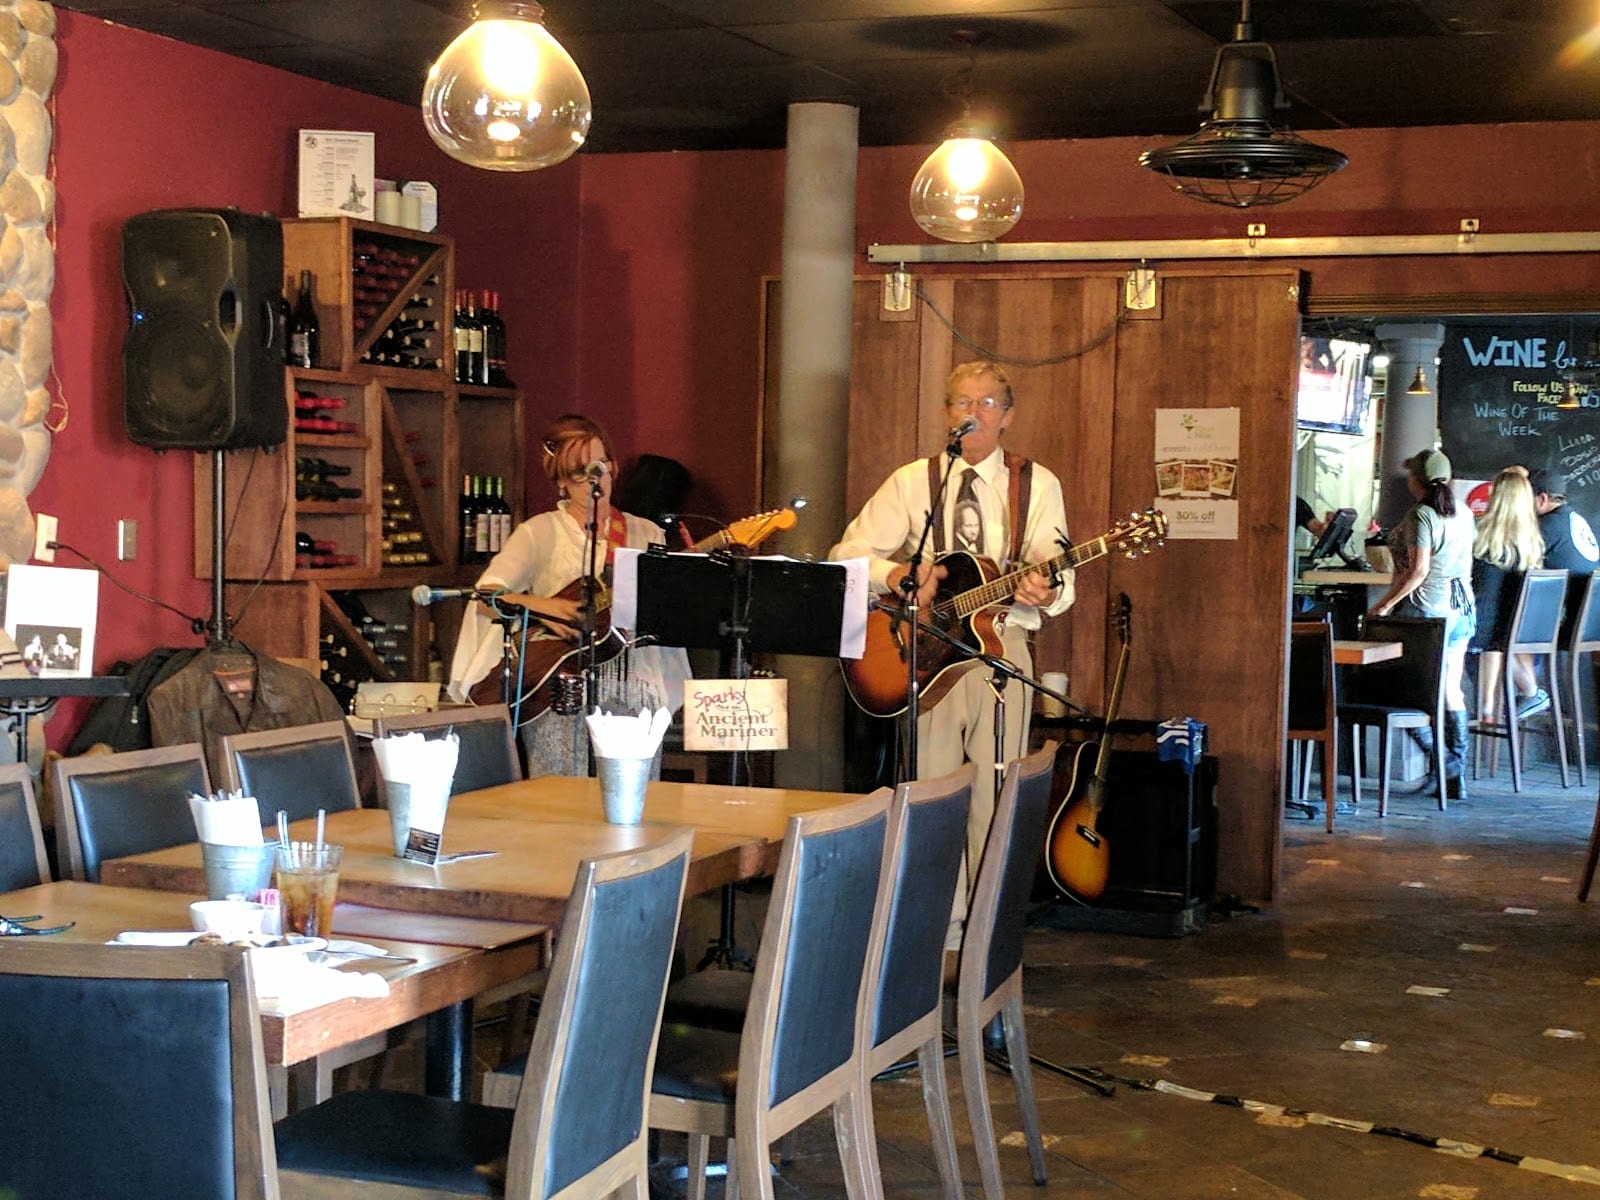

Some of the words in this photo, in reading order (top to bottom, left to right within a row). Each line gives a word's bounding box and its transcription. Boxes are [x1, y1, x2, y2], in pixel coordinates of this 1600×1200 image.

[1463, 336, 1547, 368] WINE
[1512, 381, 1548, 393] FOLLOW
[1550, 381, 1564, 393] US
[1533, 405, 1561, 421] THE
[1499, 421, 1542, 437] WEEK
[1201, 509, 1216, 521] off
[693, 686, 747, 713] Sparky
[696, 711, 769, 726] Ancient
[700, 725, 778, 741] Mariner
